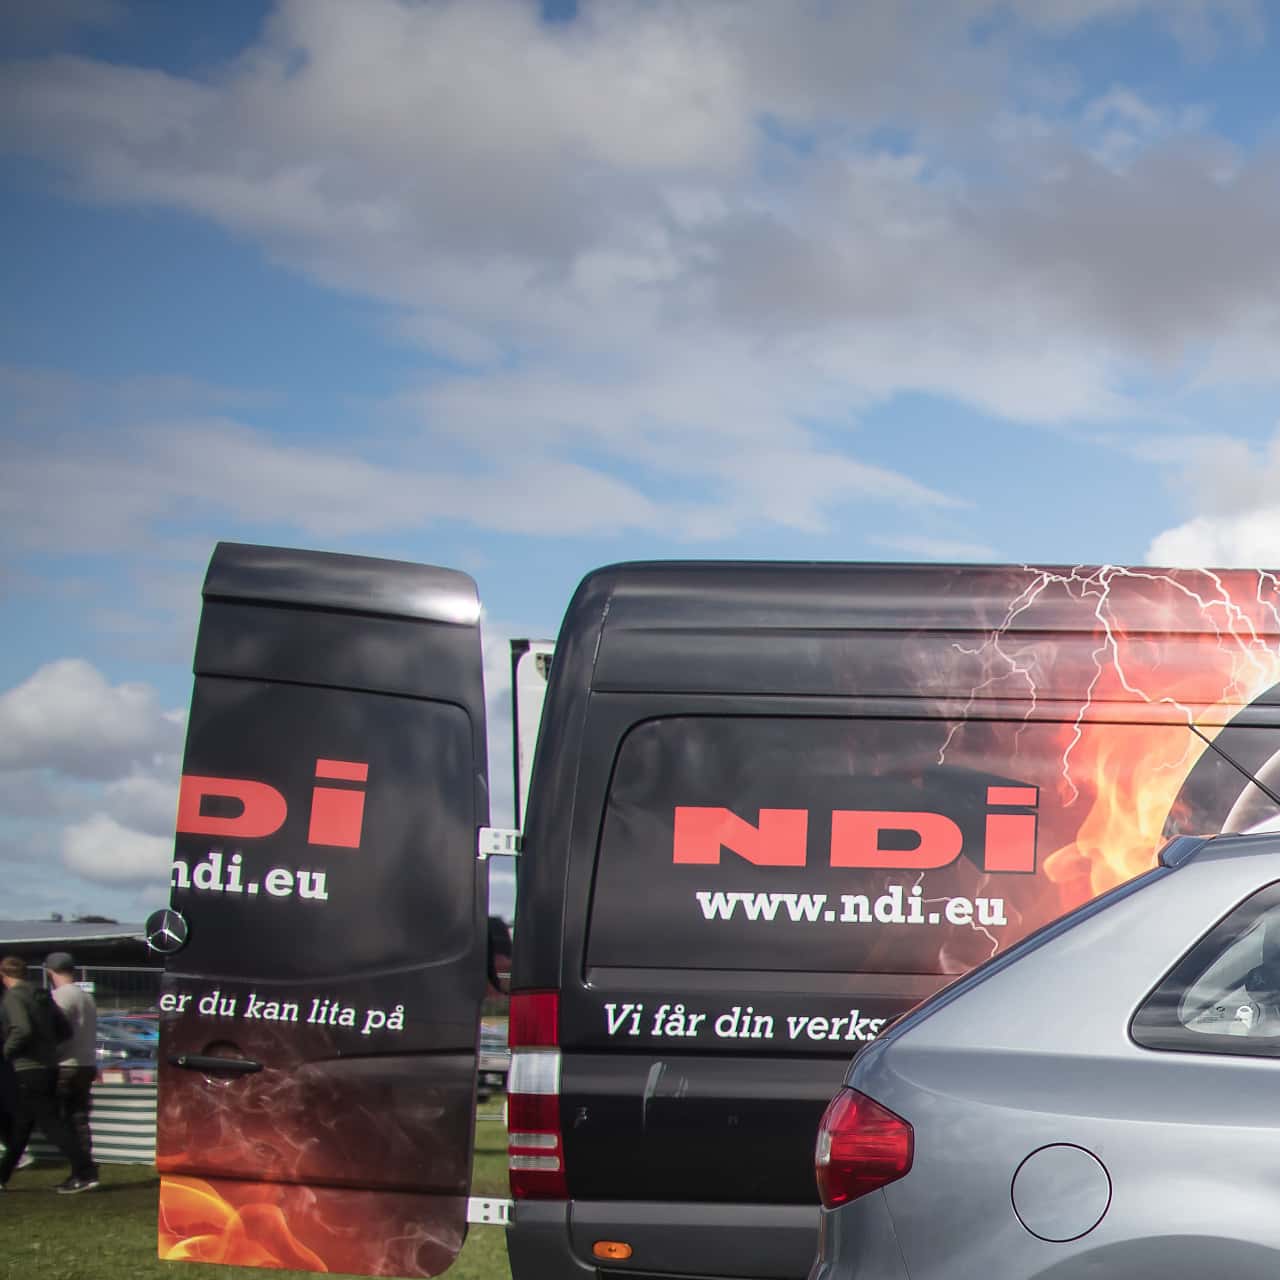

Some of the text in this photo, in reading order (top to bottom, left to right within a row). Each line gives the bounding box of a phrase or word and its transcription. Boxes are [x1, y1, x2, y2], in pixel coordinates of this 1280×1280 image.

[673, 786, 1038, 872] NDi
[696, 885, 1008, 926] www.ndi.eu
[199, 990, 237, 1017] du
[243, 993, 299, 1022] kan
[306, 998, 356, 1027] lita
[361, 1004, 405, 1035] på
[604, 1003, 643, 1036] Vi
[650, 1004, 706, 1038] får
[714, 1006, 775, 1038] din
